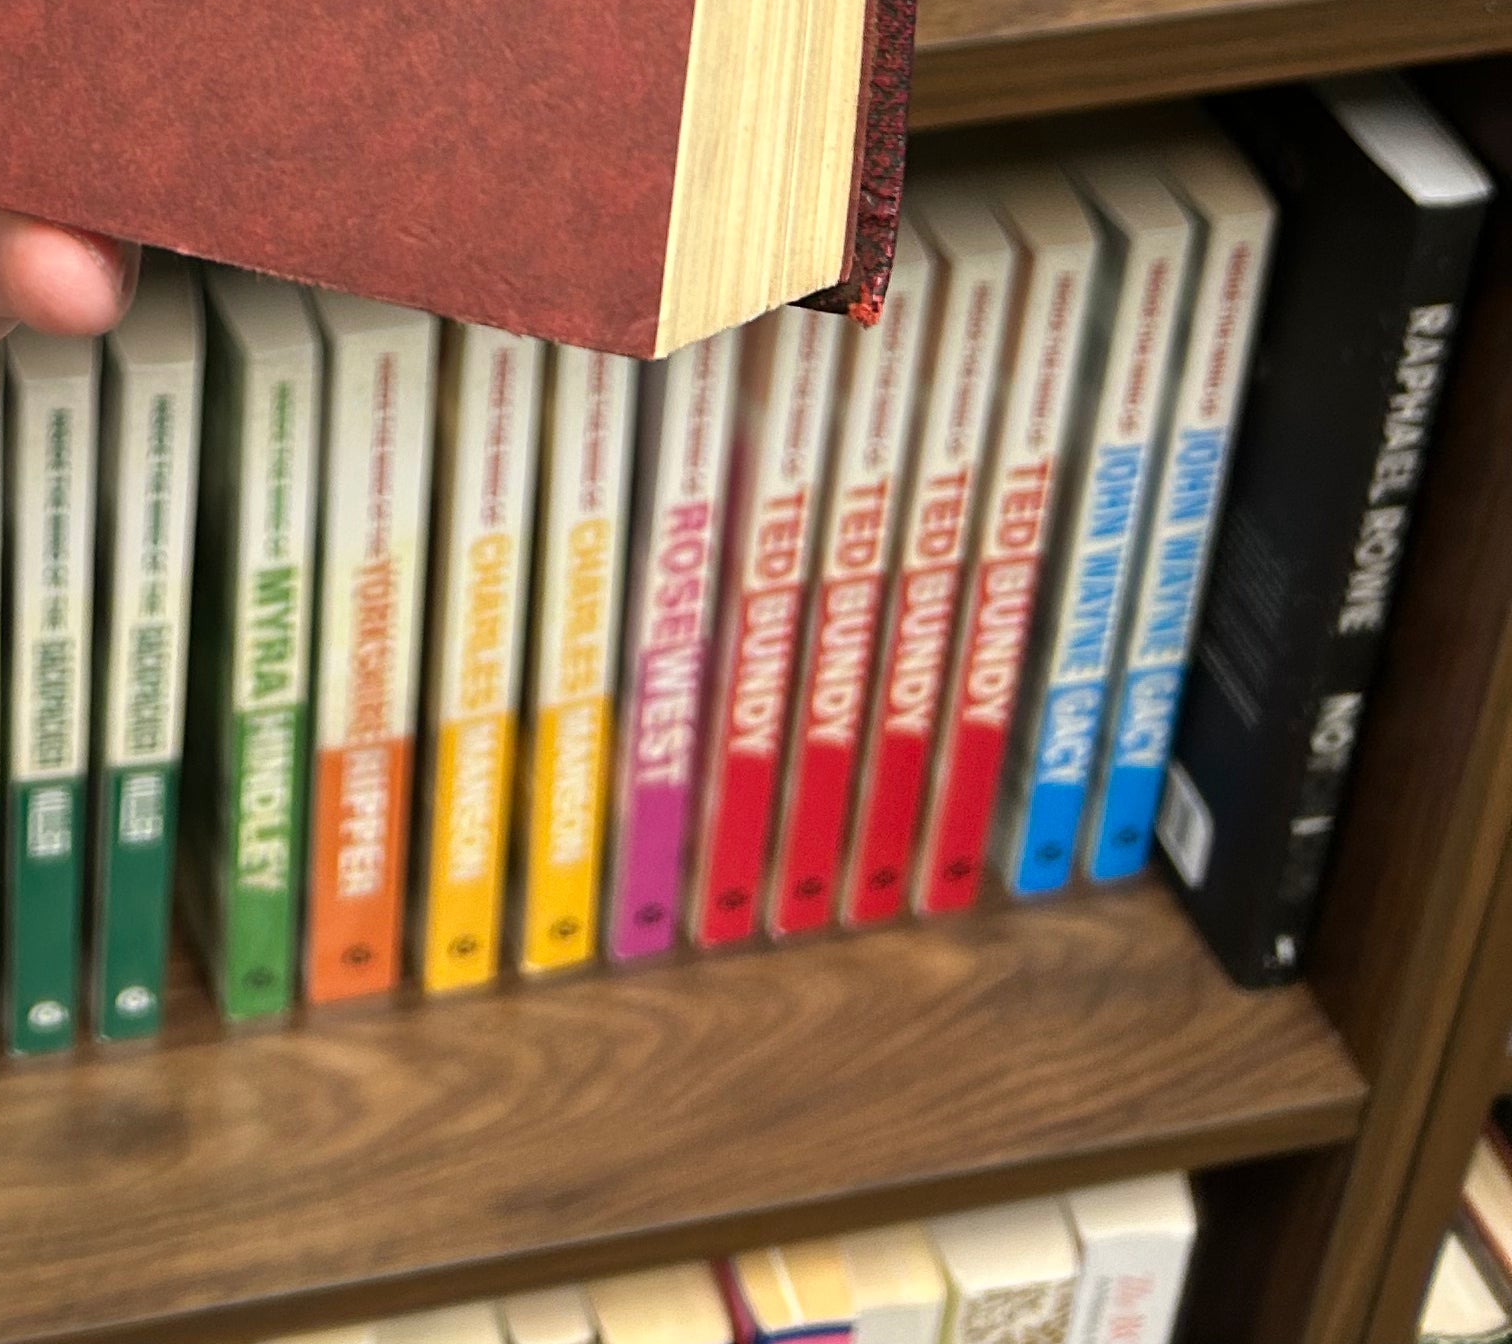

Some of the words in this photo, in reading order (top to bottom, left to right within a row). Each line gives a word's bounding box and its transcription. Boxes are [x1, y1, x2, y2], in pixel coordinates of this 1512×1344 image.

[1368, 303, 1455, 505] RAPHAEL
[654, 501, 710, 648] ROSE
[756, 490, 810, 587] TED
[834, 478, 889, 574] TED
[915, 465, 970, 561] TED
[999, 454, 1054, 558] TED
[1338, 505, 1407, 634] ROWE
[250, 564, 299, 703] MYRA
[730, 590, 797, 756] BUNDY
[808, 578, 877, 746] BUNDY
[888, 567, 957, 734] BUNDY
[966, 558, 1037, 724] BUNDY
[639, 648, 702, 784] WEST
